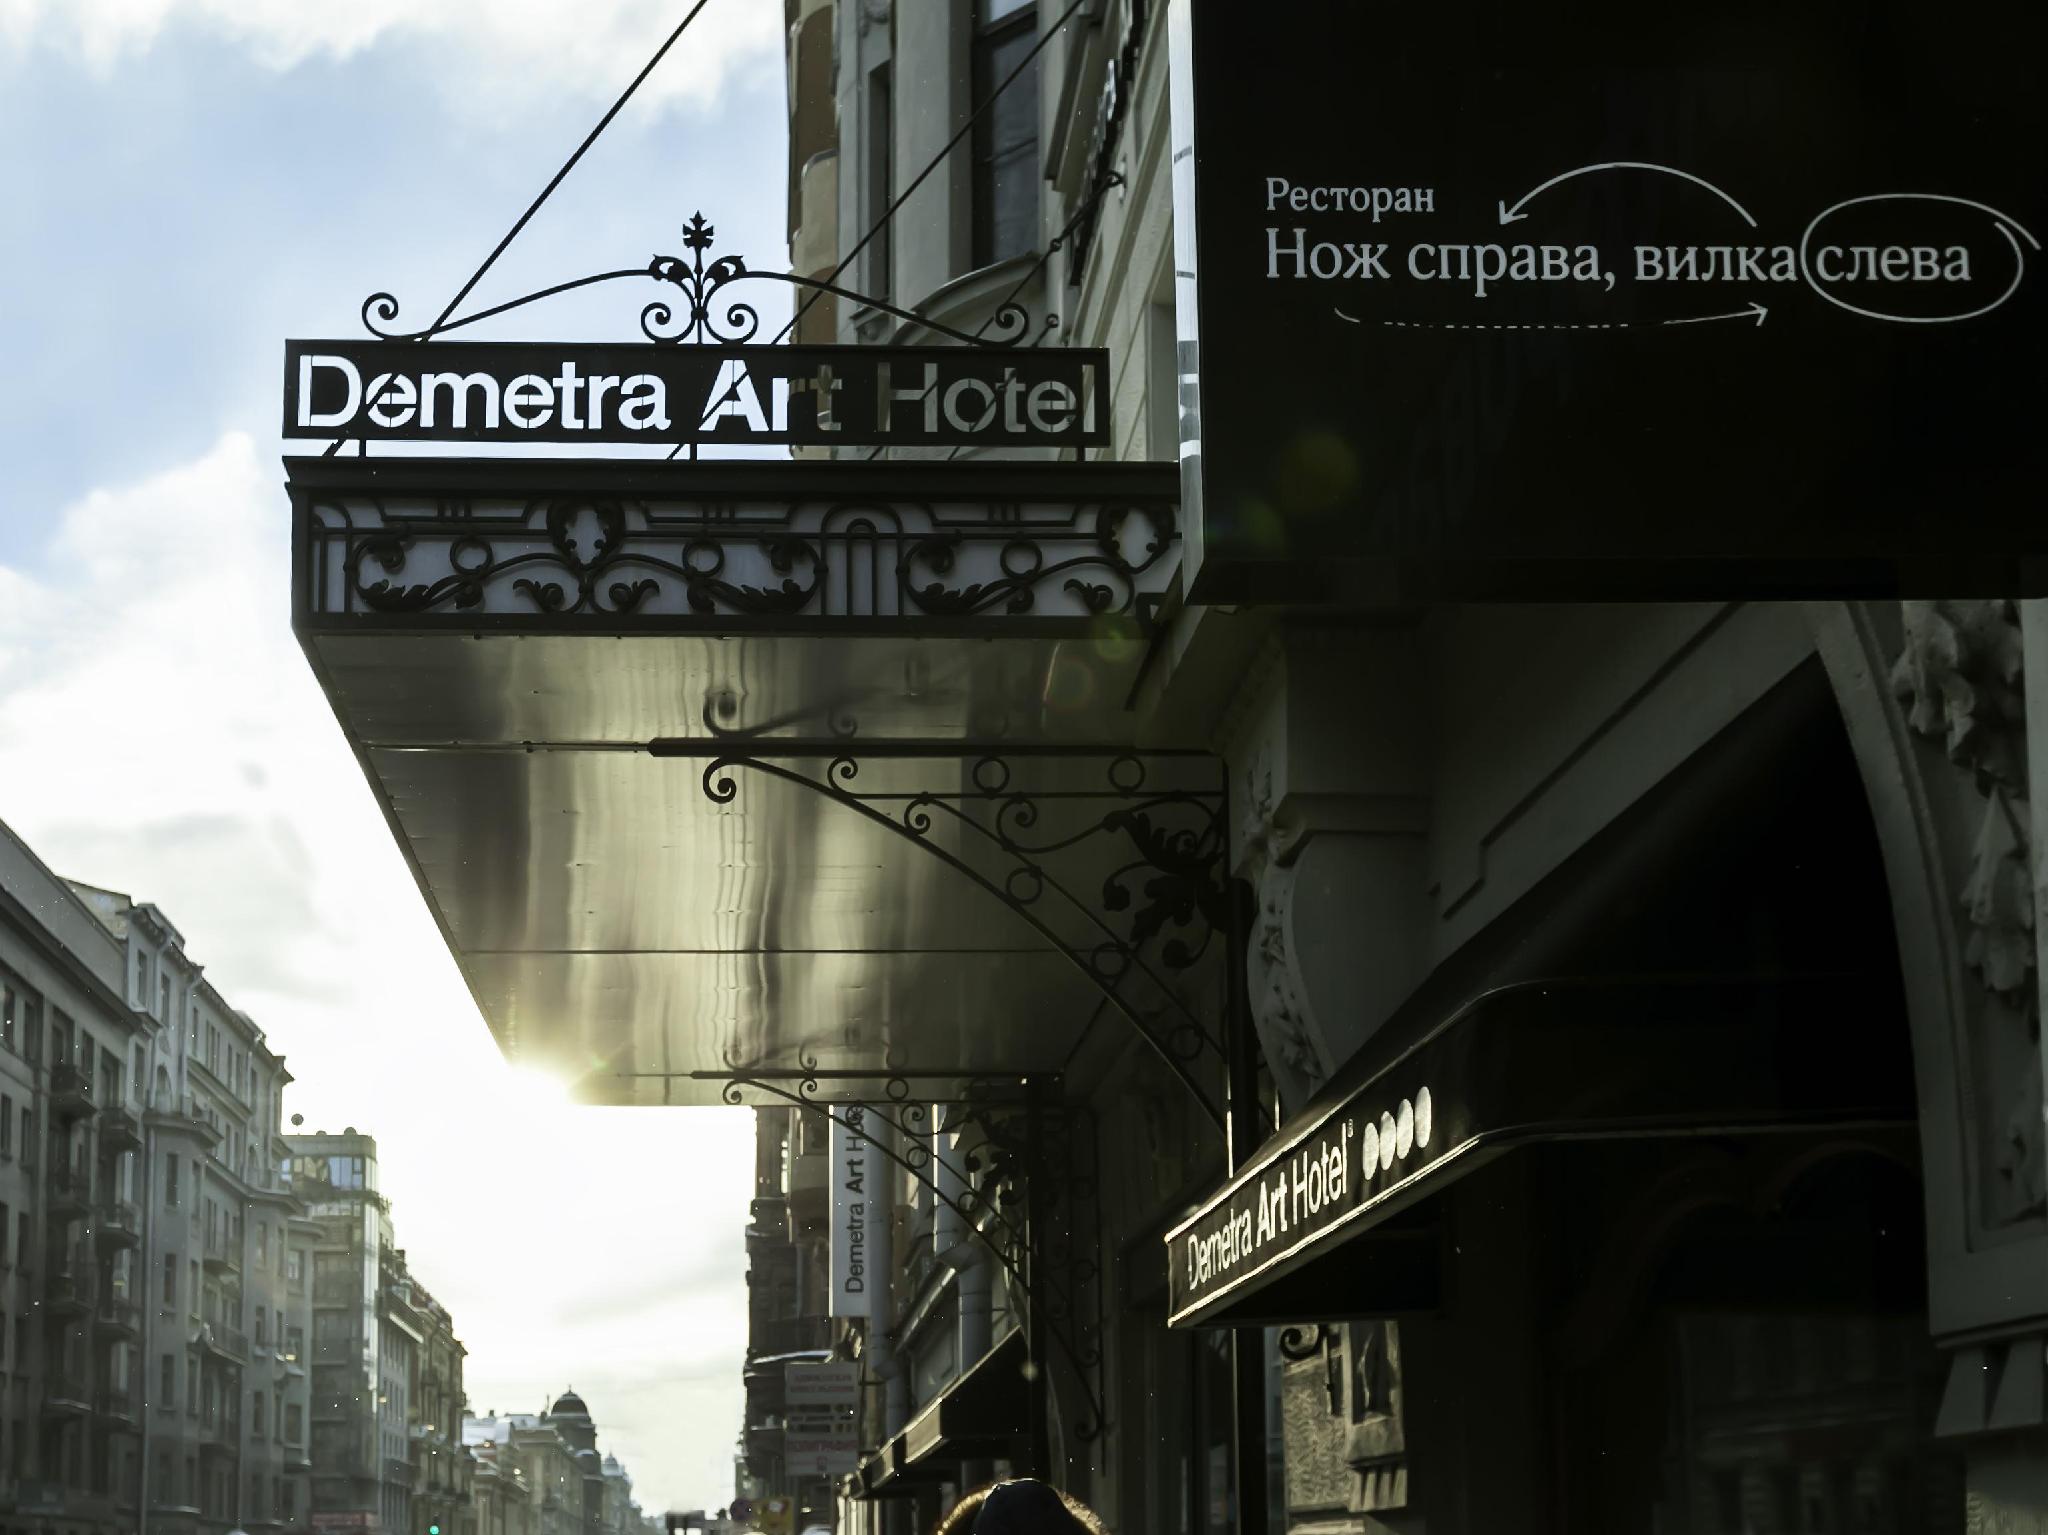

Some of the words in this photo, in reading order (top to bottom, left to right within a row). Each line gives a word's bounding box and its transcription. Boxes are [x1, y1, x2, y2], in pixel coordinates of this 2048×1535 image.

[1265, 177, 1434, 221] Ресторан
[1265, 227, 1391, 280] Нож
[1408, 242, 1616, 297] справа,
[1634, 243, 1797, 282] вилка
[1815, 244, 1971, 282] слева
[297, 355, 670, 431] Demetra
[699, 358, 843, 431] Art
[877, 362, 1096, 432] Hotel
[845, 1158, 865, 1194] Art
[845, 1202, 865, 1294] Demetra
[1187, 1207, 1253, 1291] Demetra
[1256, 1171, 1288, 1249] Art
